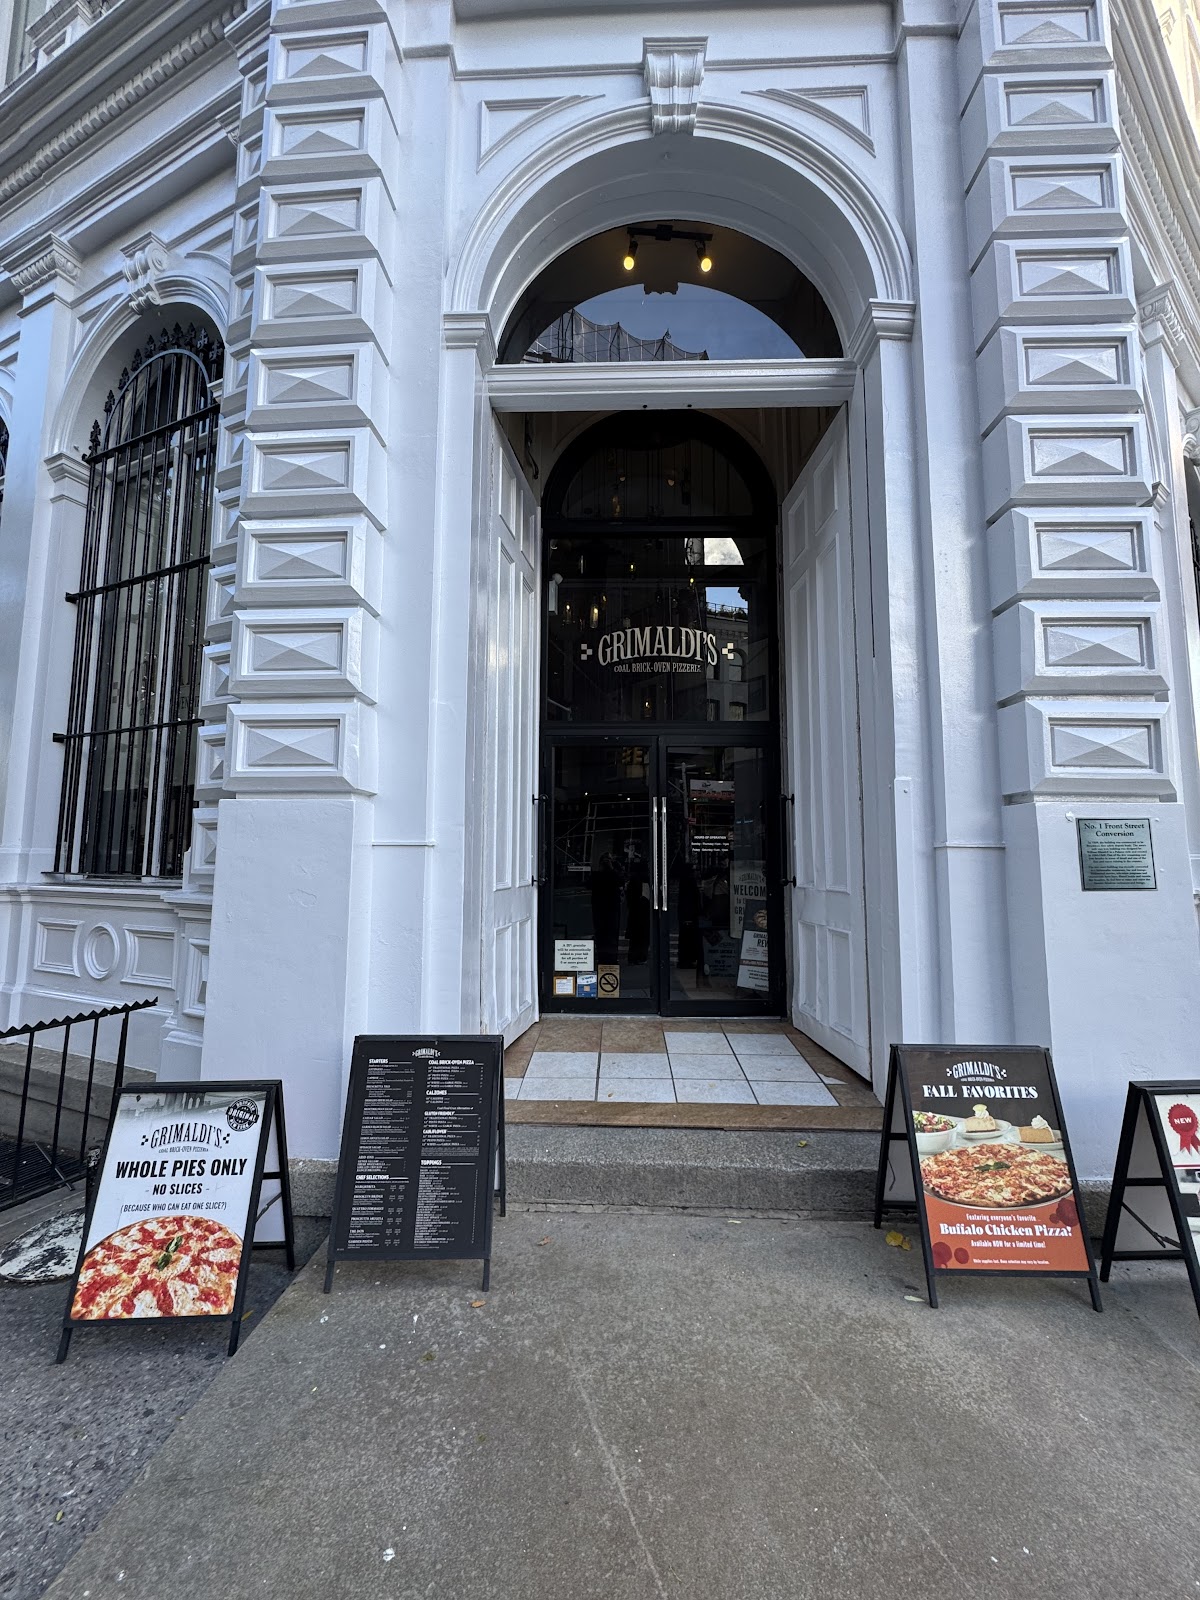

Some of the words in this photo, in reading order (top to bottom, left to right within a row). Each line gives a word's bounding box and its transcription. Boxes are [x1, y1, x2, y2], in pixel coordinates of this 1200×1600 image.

[598, 626, 718, 666] GRIMALDI'S
[614, 663, 630, 672] COAL
[632, 662, 670, 672] BRICK-OVEN
[952, 1061, 1001, 1079] GRIMALDI'S
[922, 1085, 958, 1098] FALL
[962, 1085, 1038, 1099] FAVORITES
[150, 1123, 222, 1148] GRIMALDI'S
[116, 1160, 168, 1178] WHOLE
[171, 1160, 206, 1177] PIES
[210, 1158, 247, 1176] ONLY
[152, 1184, 167, 1196] NO
[170, 1183, 203, 1195] SLICES
[120, 1203, 151, 1213] (BECAUSE
[192, 1202, 204, 1210] ONE
[205, 1202, 227, 1210] SLICE?)
[966, 1214, 989, 1222] Featuring
[940, 1223, 984, 1235] Buffalo
[985, 1224, 1033, 1236] Chicken
[1034, 1225, 1072, 1237] Pizza!
